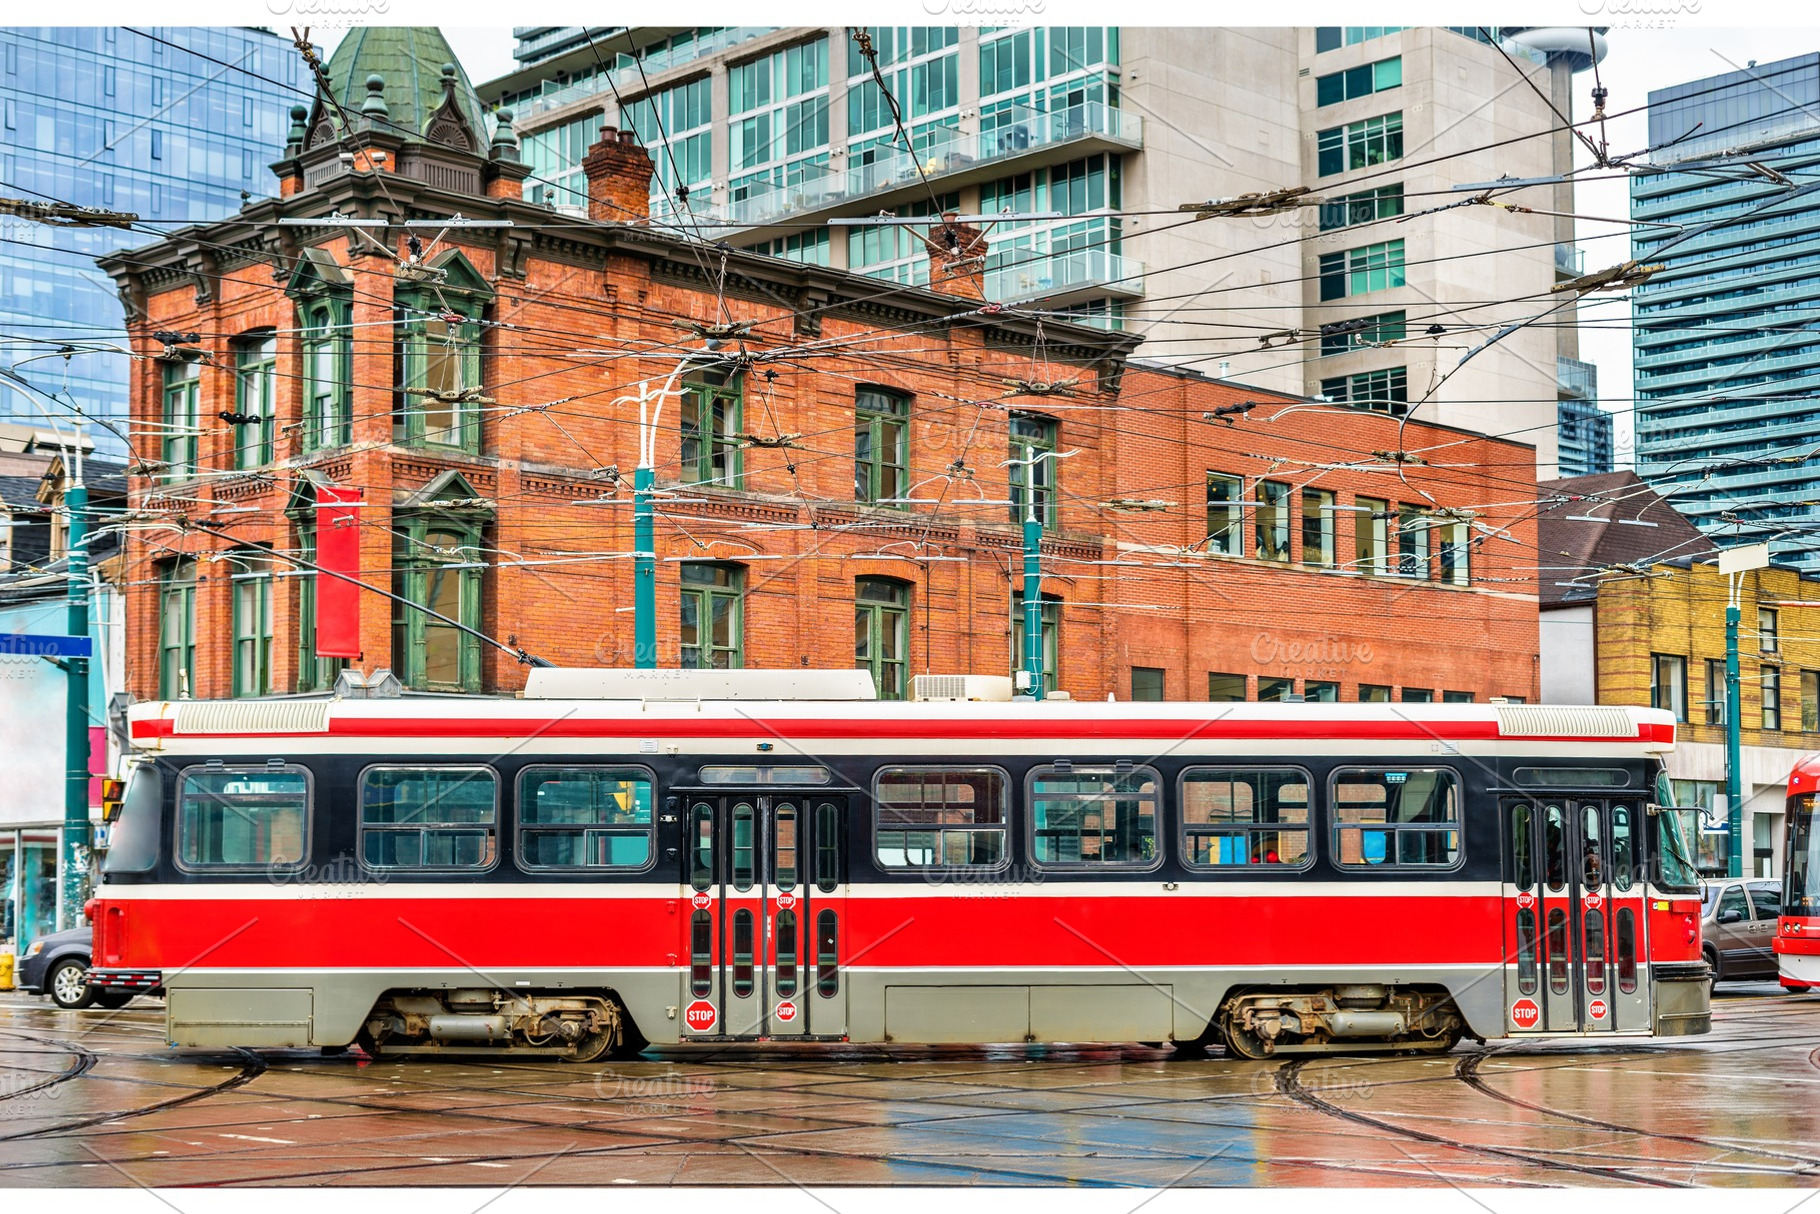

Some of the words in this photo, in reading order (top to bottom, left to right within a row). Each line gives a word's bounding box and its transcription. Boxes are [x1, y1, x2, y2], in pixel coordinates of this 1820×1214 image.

[694, 896, 708, 905] STOP
[779, 896, 793, 905] STOP
[1519, 896, 1532, 904] STOP
[1587, 896, 1600, 904] STOP
[779, 1007, 795, 1016] STOP
[1515, 1008, 1536, 1018] STOP
[1591, 1005, 1606, 1014] STOP
[688, 1011, 713, 1021] STOP
